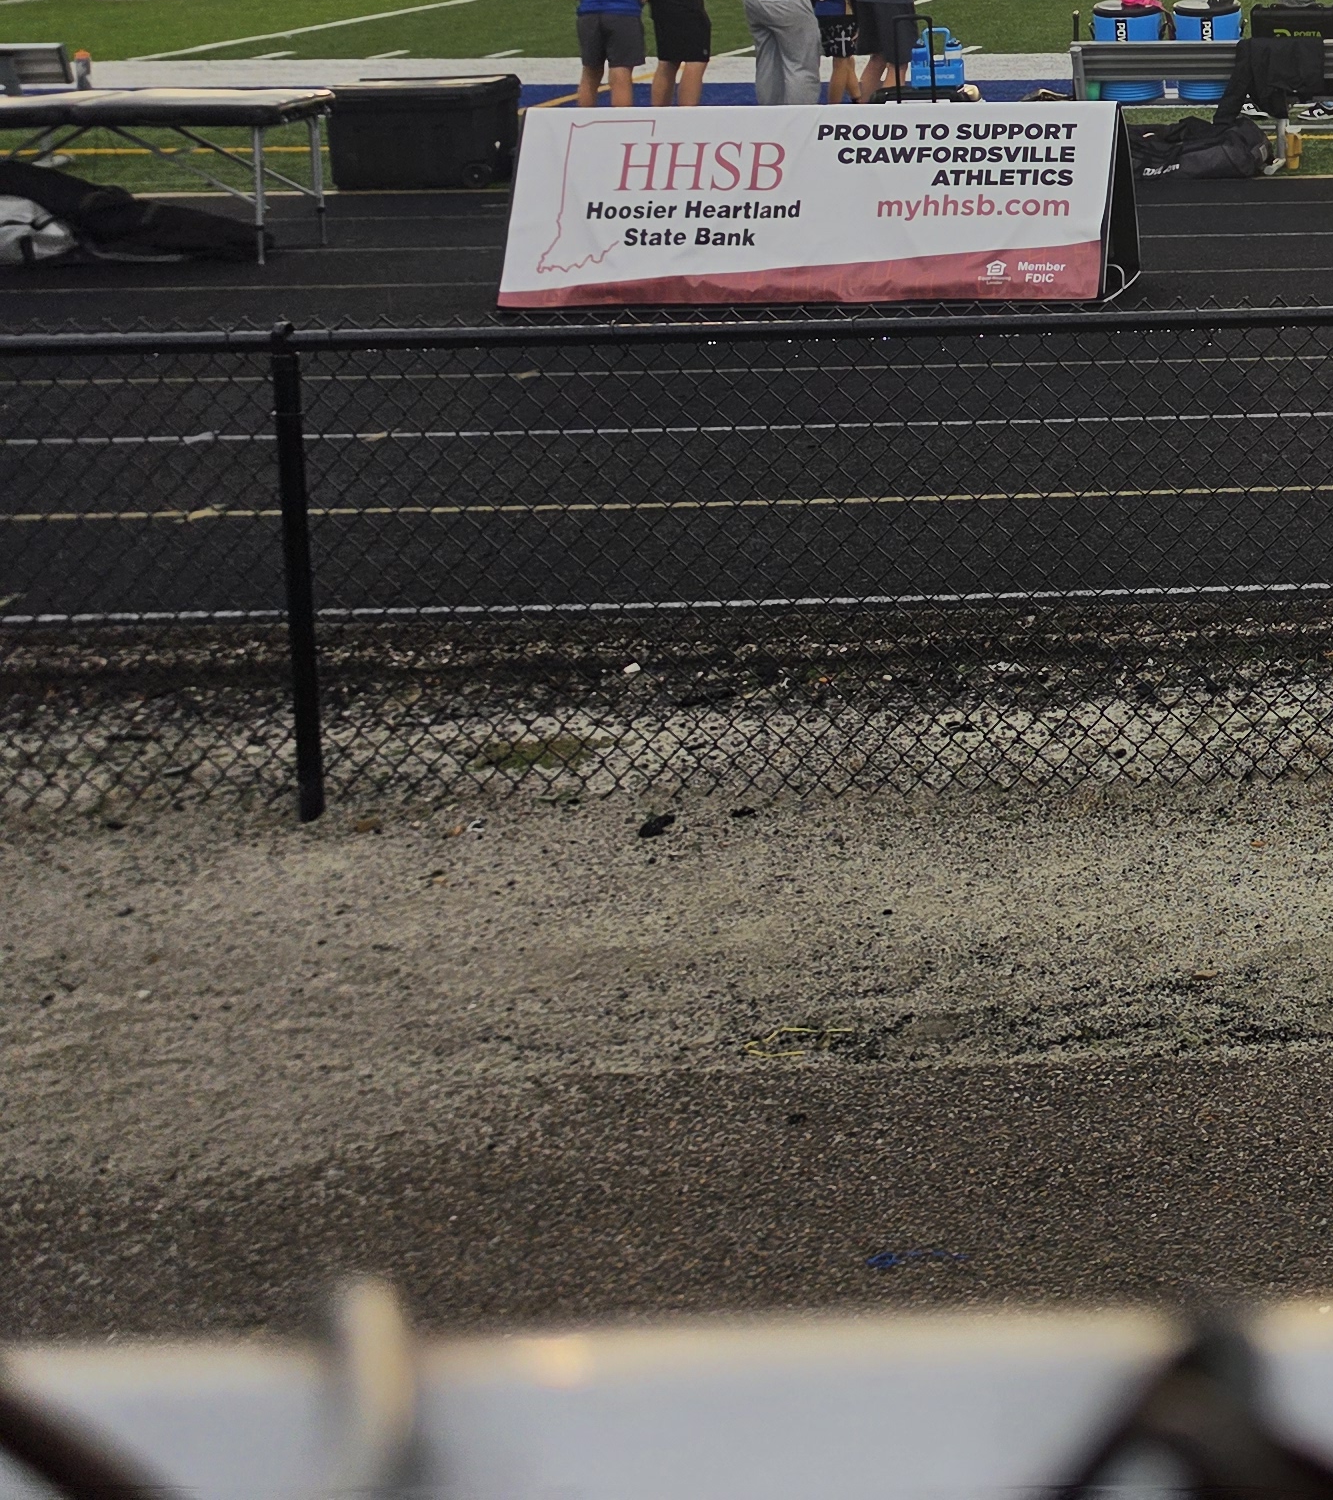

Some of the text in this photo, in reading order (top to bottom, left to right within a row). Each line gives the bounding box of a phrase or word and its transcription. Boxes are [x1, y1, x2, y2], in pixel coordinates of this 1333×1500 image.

[818, 123, 1078, 140] PROUD TO SUPPORT
[838, 146, 1075, 164] CRAWFORDSVILLE
[613, 141, 786, 191] HHSB
[931, 169, 1074, 186] ATHLETICS
[586, 200, 801, 219] Hoosier Heartland
[877, 194, 1070, 221] myhhsb.com
[624, 228, 755, 246] State Bank
[1018, 261, 1066, 272] Member
[1025, 273, 1055, 283] FDIC
